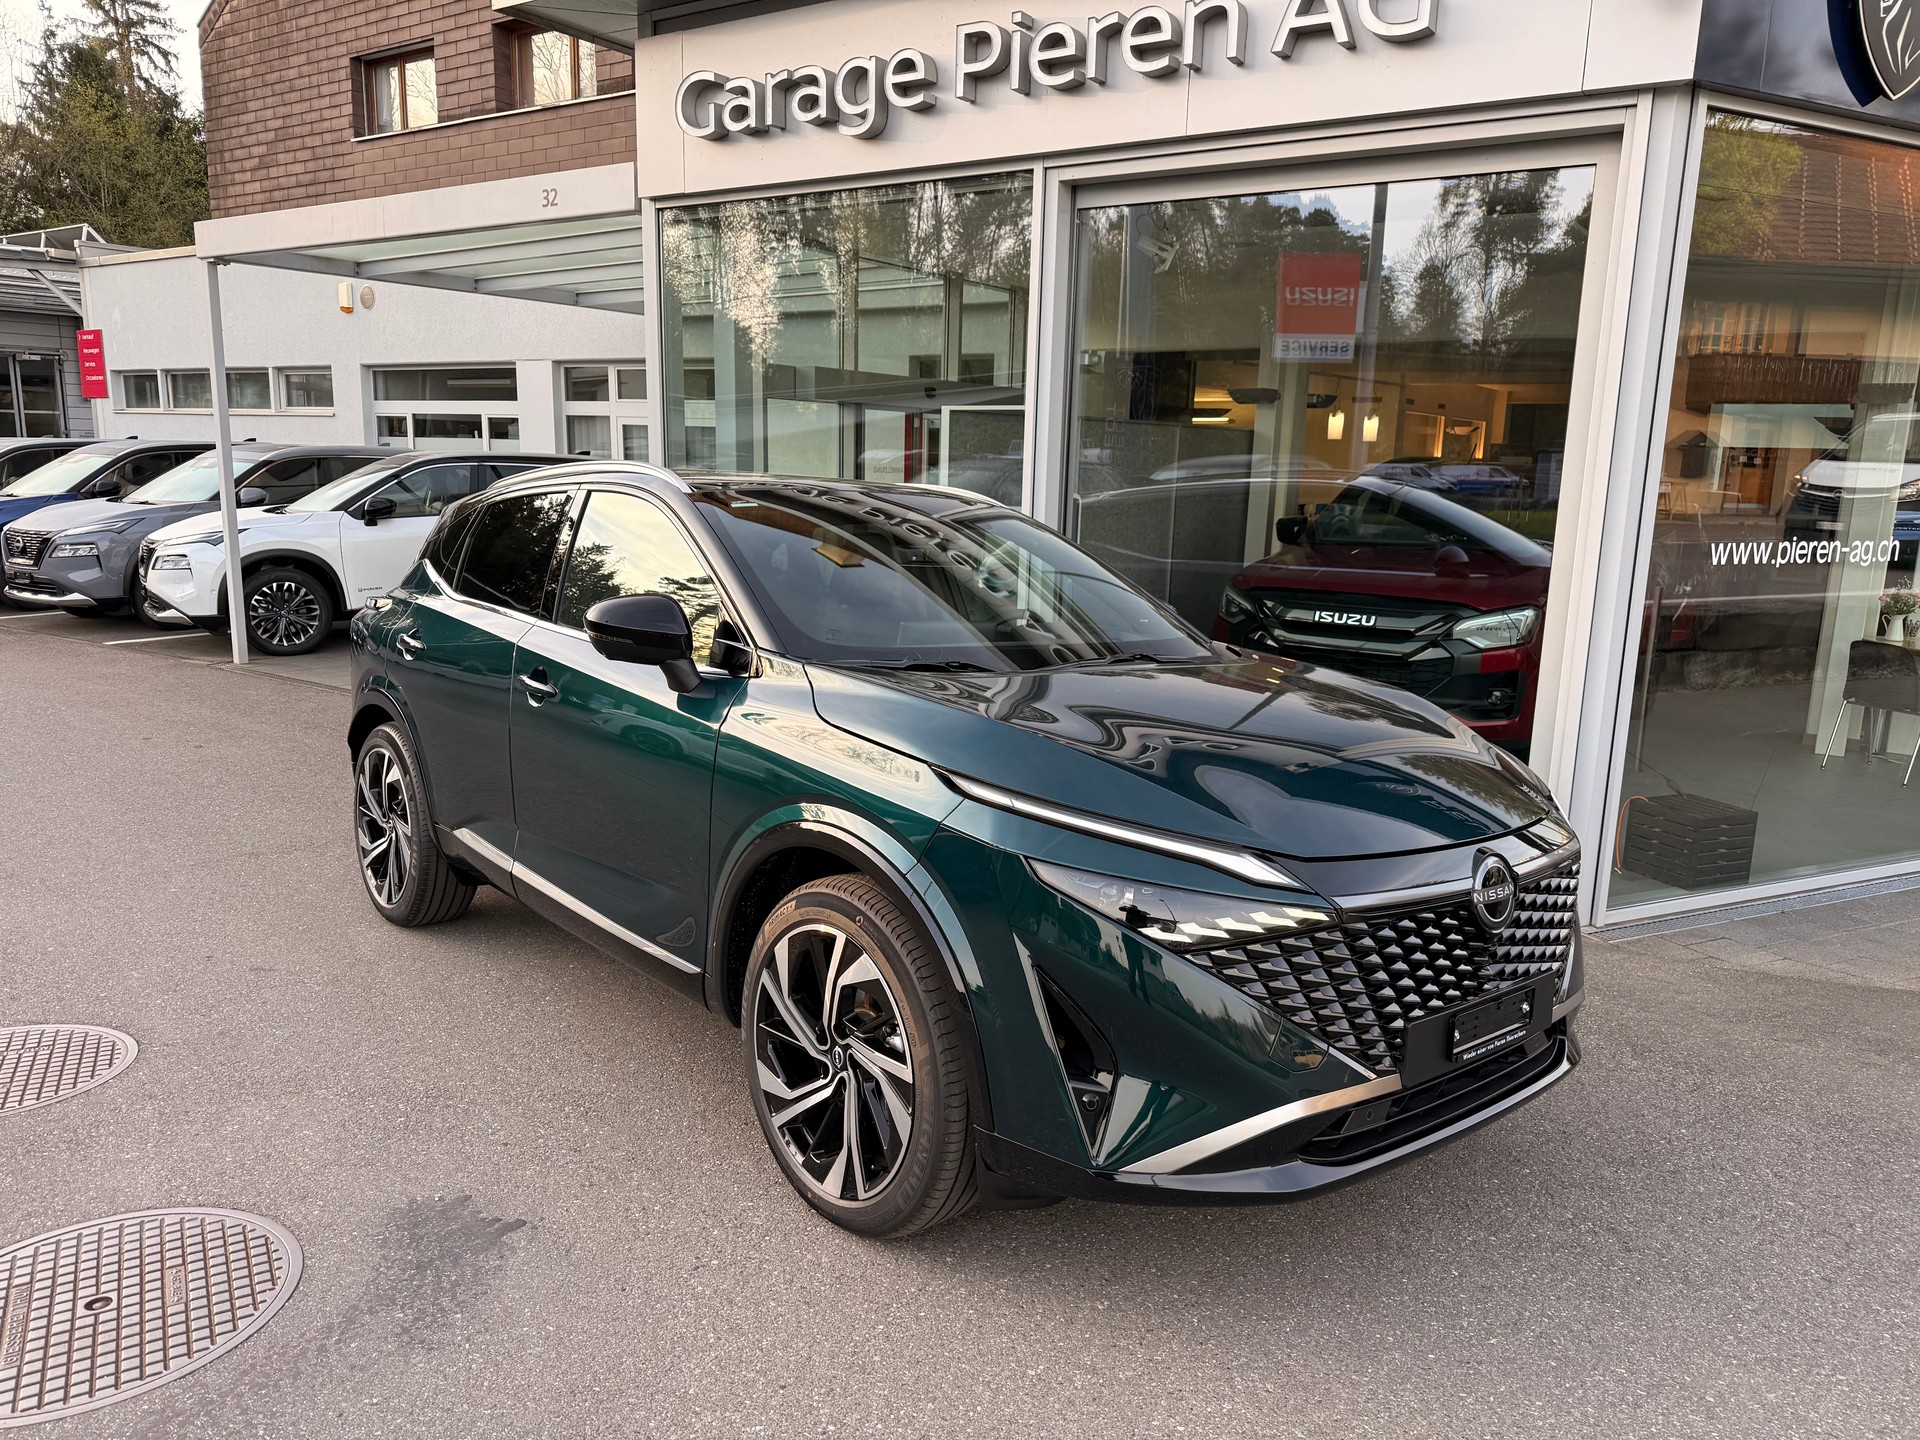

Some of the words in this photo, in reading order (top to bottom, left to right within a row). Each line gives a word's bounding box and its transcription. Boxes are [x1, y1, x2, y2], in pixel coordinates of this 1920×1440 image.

[675, 48, 937, 140] Garage
[954, 0, 1247, 103] Pieren
[541, 188, 558, 208] 32
[1711, 536, 1900, 568] www.pieren-ag.ch
[1314, 610, 1376, 627] ISUZU
[1473, 883, 1514, 903] NISSAN
